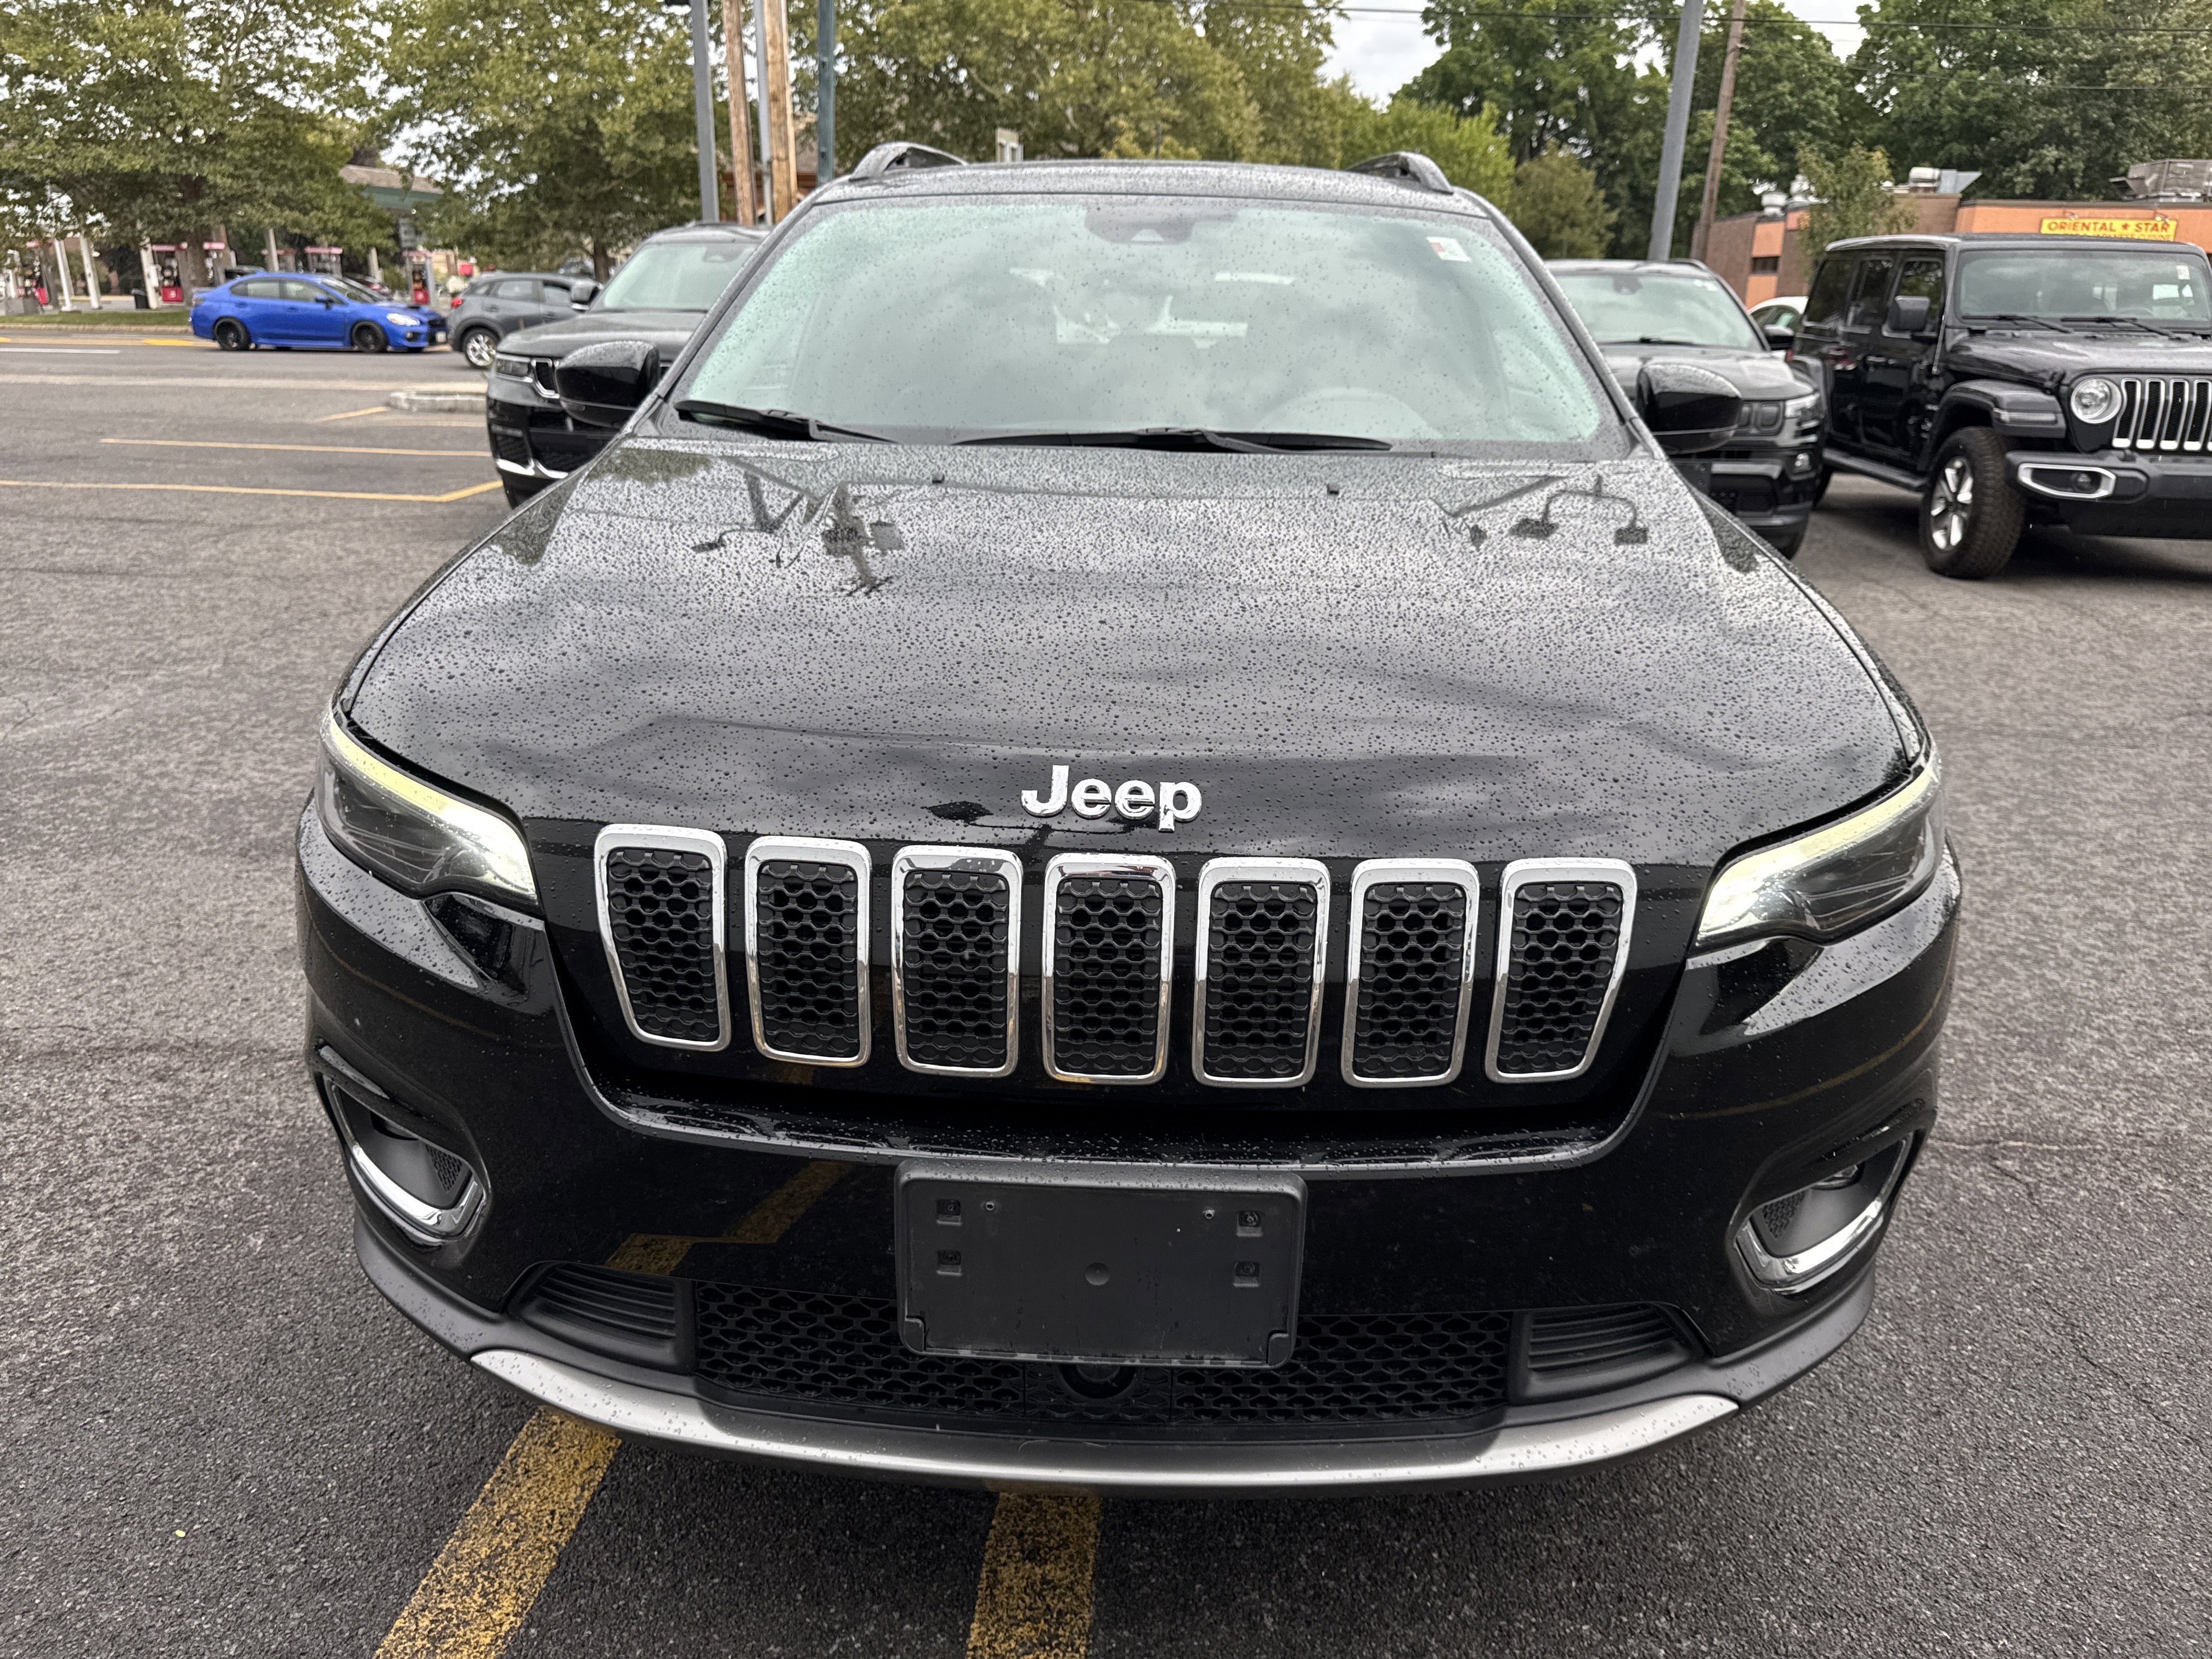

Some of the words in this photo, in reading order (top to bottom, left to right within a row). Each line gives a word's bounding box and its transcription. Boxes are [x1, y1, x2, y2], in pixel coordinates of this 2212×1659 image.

[2047, 221, 2117, 232] ORIENTAL
[2135, 222, 2170, 233] STAR
[1021, 765, 1203, 833] Jeep
